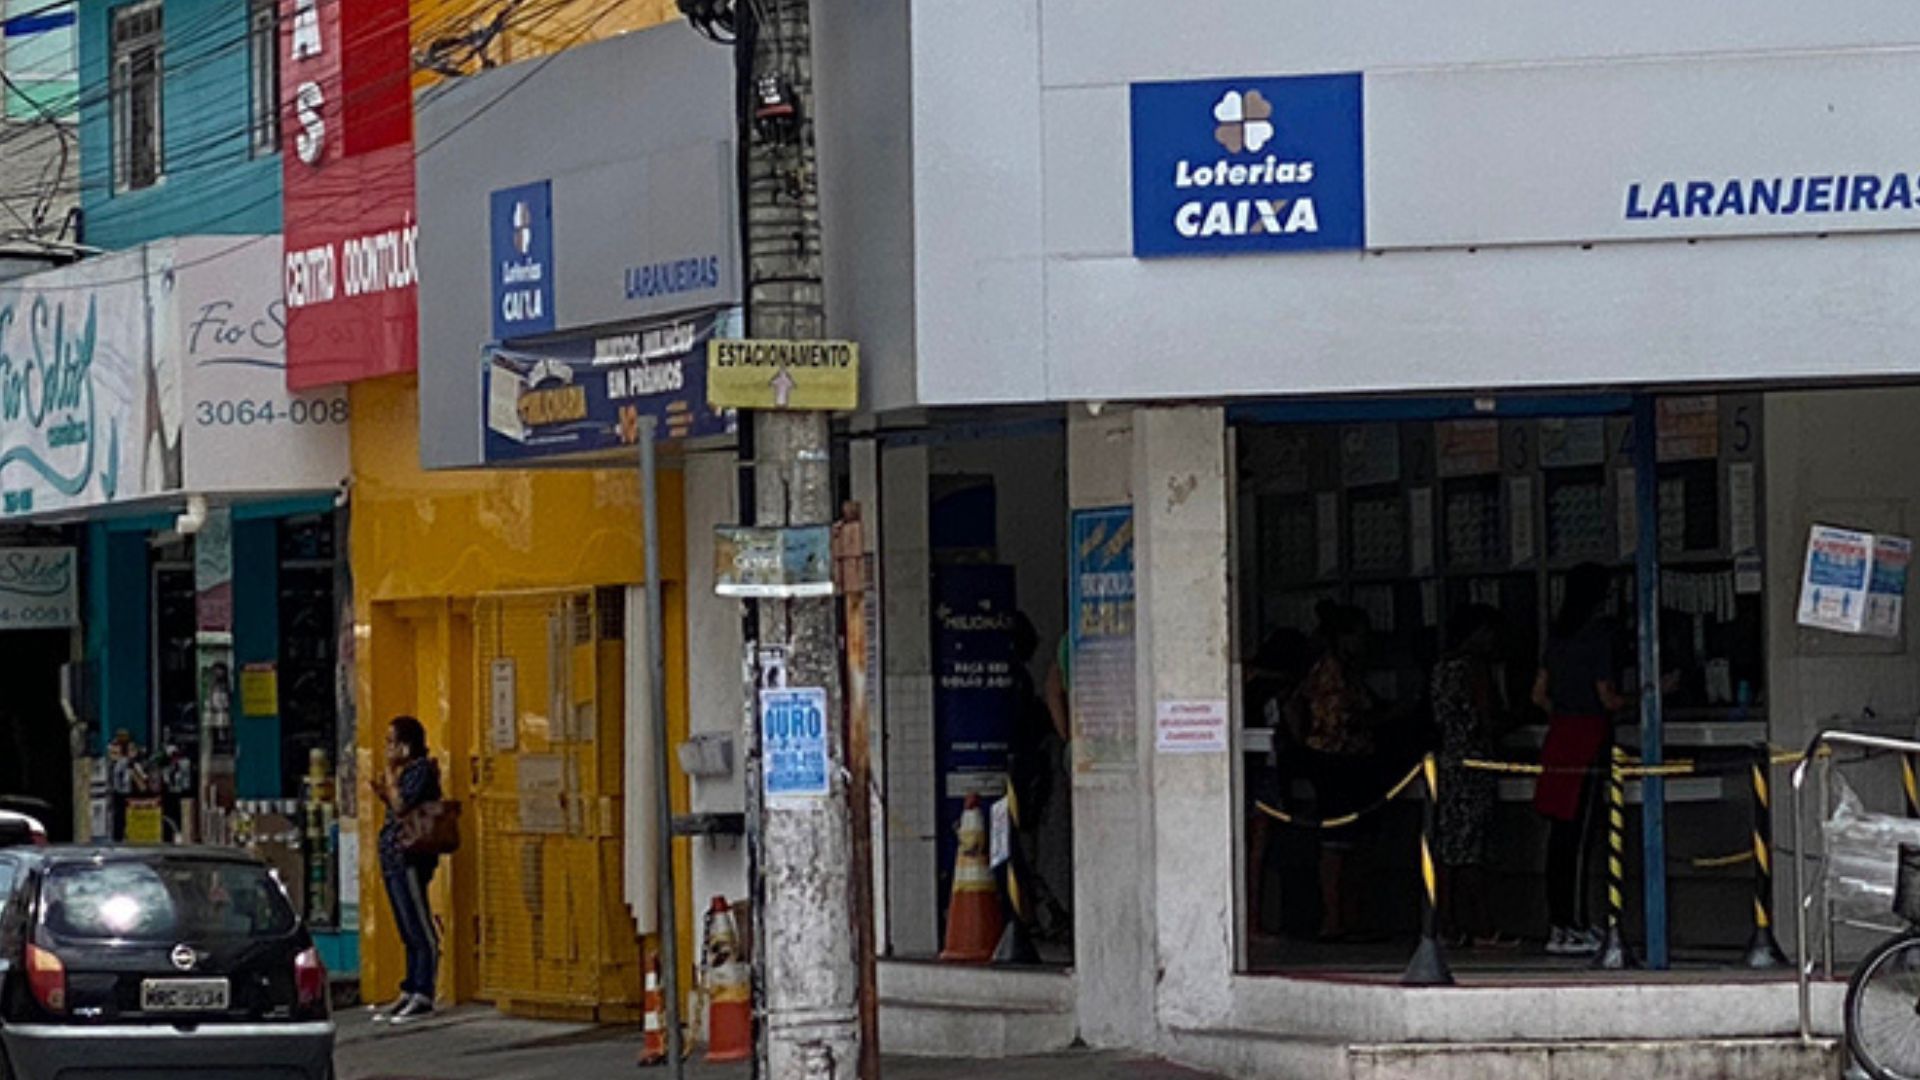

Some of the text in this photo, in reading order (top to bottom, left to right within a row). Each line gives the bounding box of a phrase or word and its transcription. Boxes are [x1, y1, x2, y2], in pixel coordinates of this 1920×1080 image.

[1175, 155, 1314, 188] Loterias
[1174, 197, 1319, 238] CAIXA
[1625, 172, 1920, 219] LARANJEIRA
[286, 243, 334, 308] CENTRO
[624, 254, 720, 299] LARANJEIRAS
[190, 301, 245, 354] Fio
[717, 344, 850, 367] ESTACIONAMENTO
[1734, 405, 1750, 453] 5
